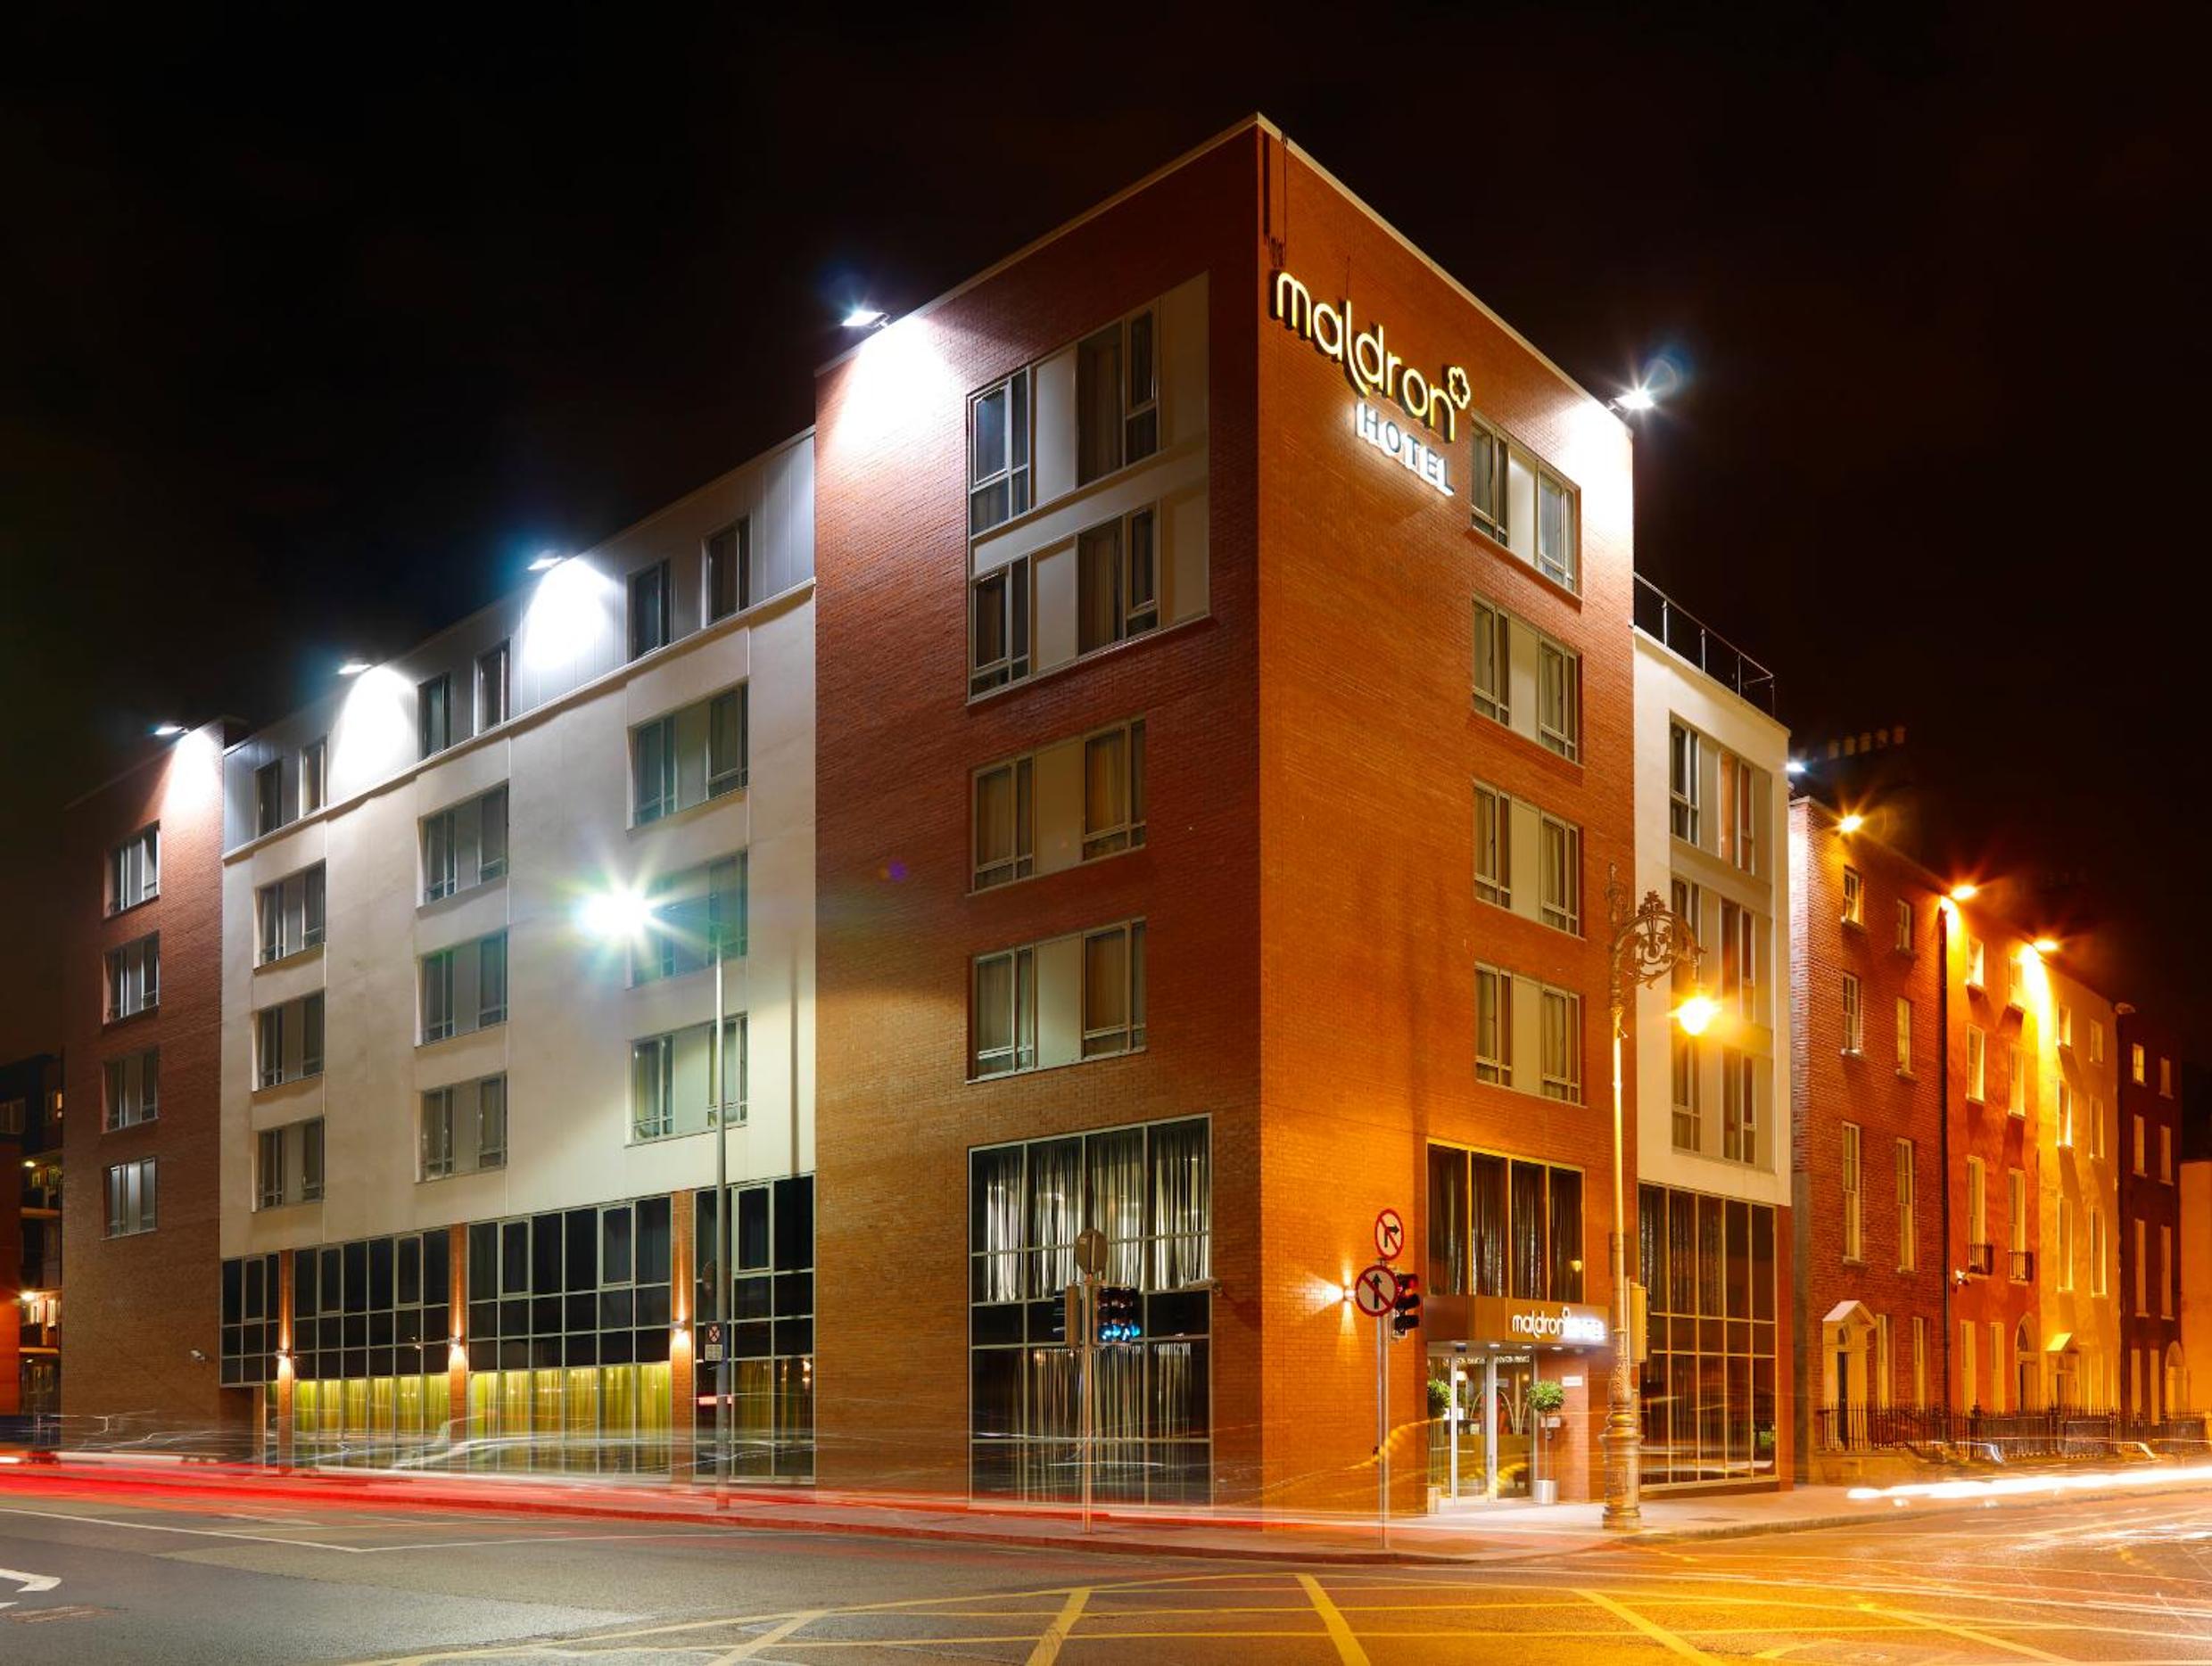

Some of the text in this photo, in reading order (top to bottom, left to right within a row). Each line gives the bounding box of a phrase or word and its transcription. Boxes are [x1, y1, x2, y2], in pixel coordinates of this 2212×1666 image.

[1275, 271, 1457, 442] maldron
[1357, 402, 1455, 496] HOTEL
[1512, 1309, 1565, 1339] maldron
